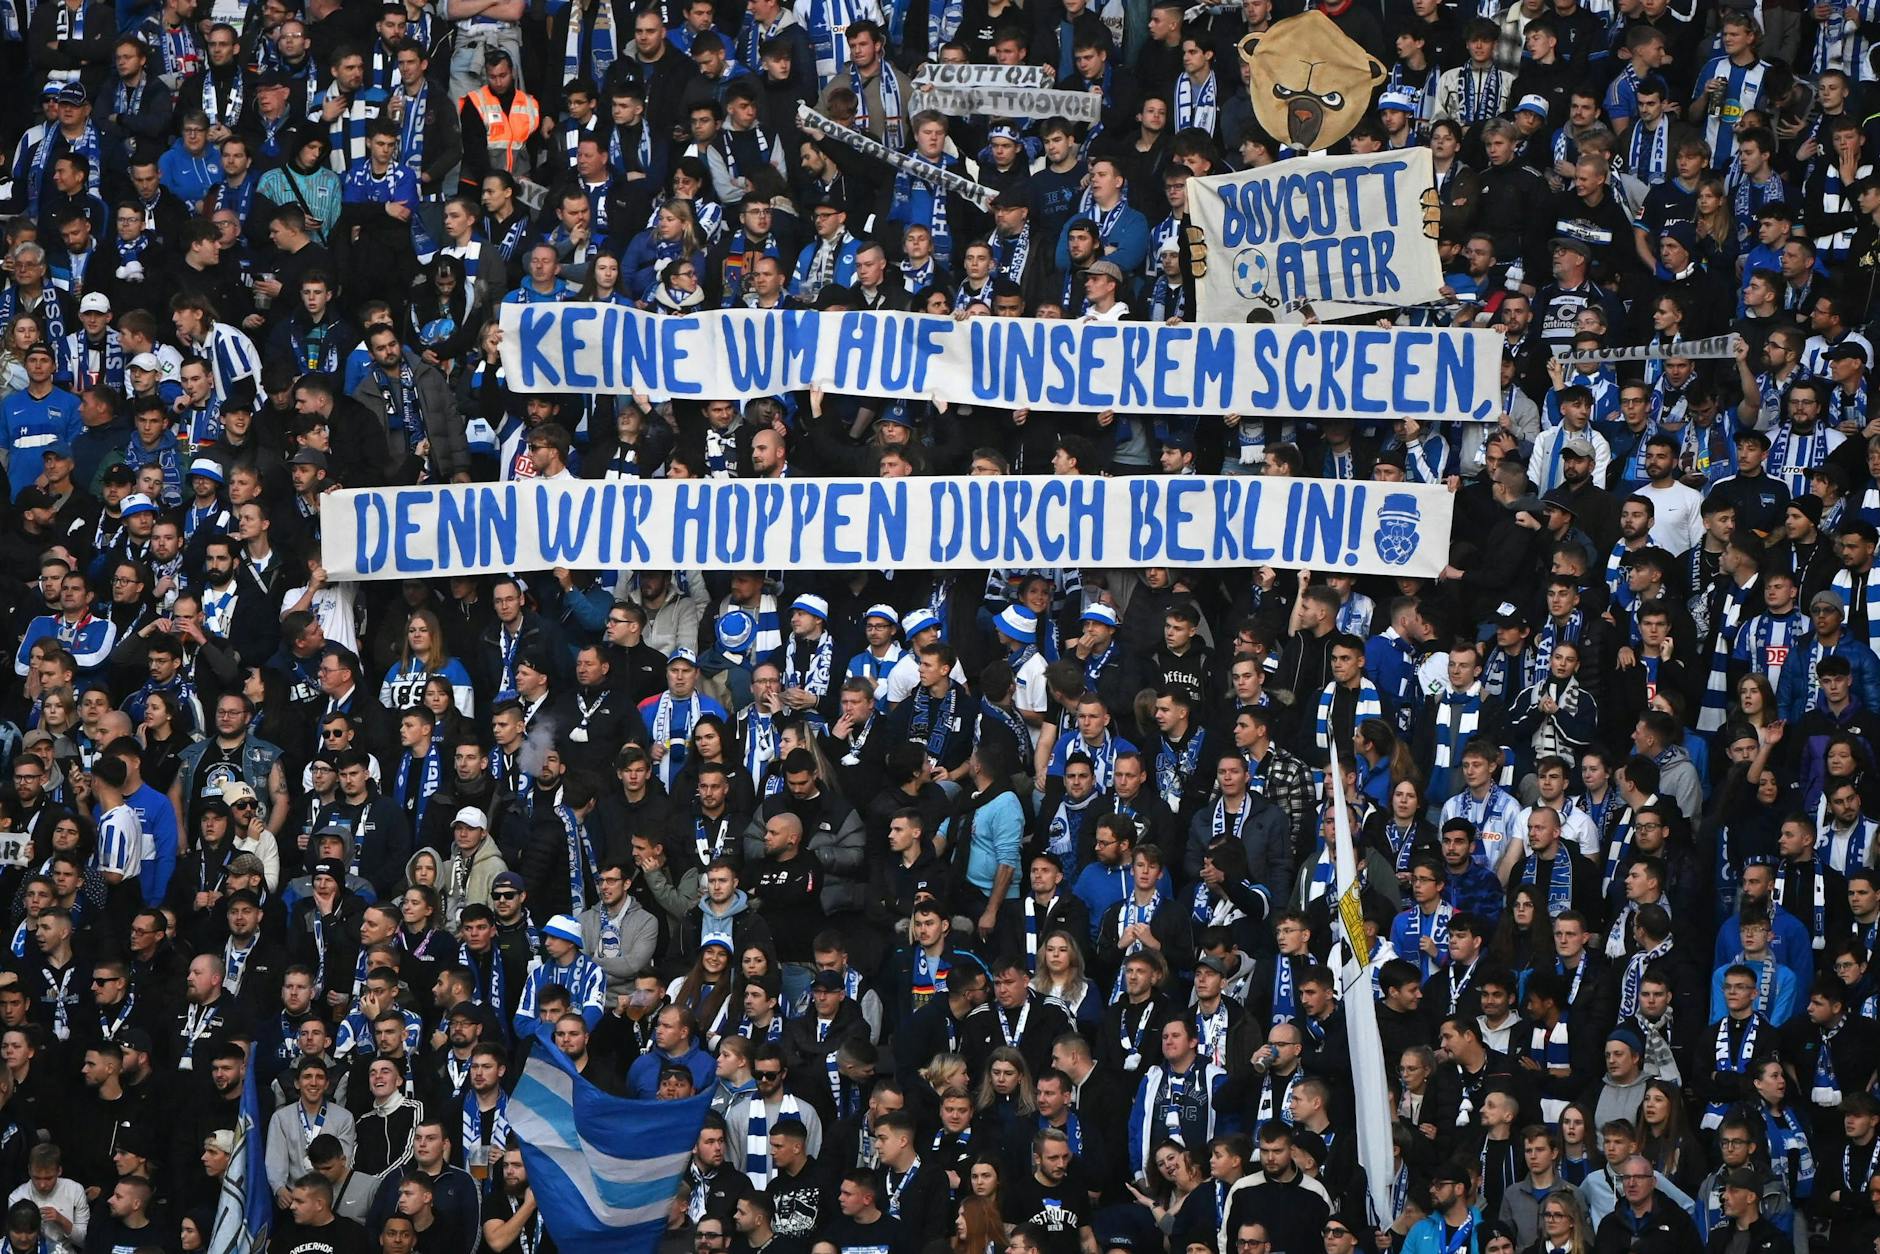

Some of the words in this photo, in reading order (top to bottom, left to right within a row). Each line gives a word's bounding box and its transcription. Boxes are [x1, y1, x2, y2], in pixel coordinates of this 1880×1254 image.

[805, 112, 906, 169] BOYCOTT
[1218, 161, 1407, 248] BOYCOTT
[43, 287, 65, 340] BSC
[519, 306, 703, 394] KEINE
[722, 308, 820, 393] WM
[835, 312, 954, 393] AUF
[970, 321, 1236, 409] UNSEREM
[1251, 328, 1492, 420] SCREEN,
[354, 485, 517, 574] DENN
[536, 484, 653, 564] WIR
[672, 481, 908, 564] HOPPEN
[930, 479, 1105, 562] DURCH
[1129, 479, 1367, 566] BERLIN!
[1766, 649, 1787, 664] DB
